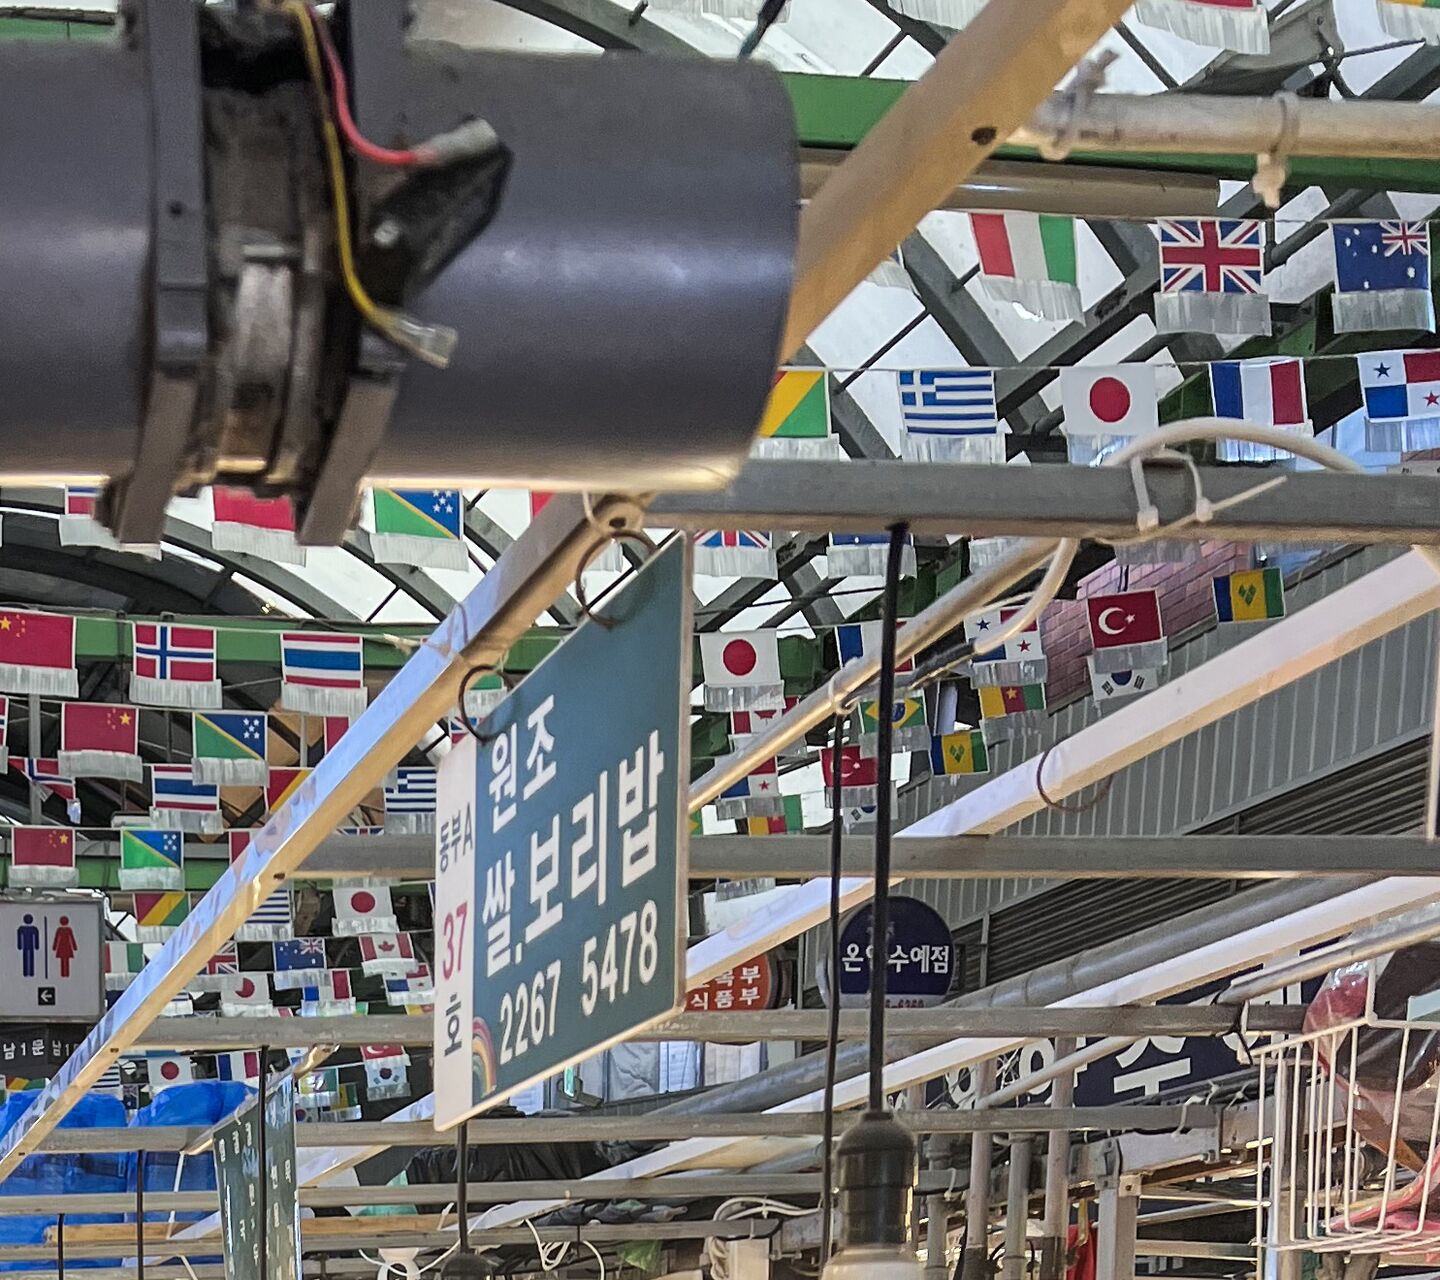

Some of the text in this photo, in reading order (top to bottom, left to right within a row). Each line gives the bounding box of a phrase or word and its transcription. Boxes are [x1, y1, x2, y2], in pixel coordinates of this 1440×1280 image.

[489, 694, 557, 834] 원조
[439, 801, 474, 873] 동부A
[442, 903, 468, 981] 37
[841, 942, 950, 975] 온수예점
[500, 899, 658, 1065] 2267 5478
[690, 986, 761, 1010] 식품부
[444, 996, 463, 1057] 호
